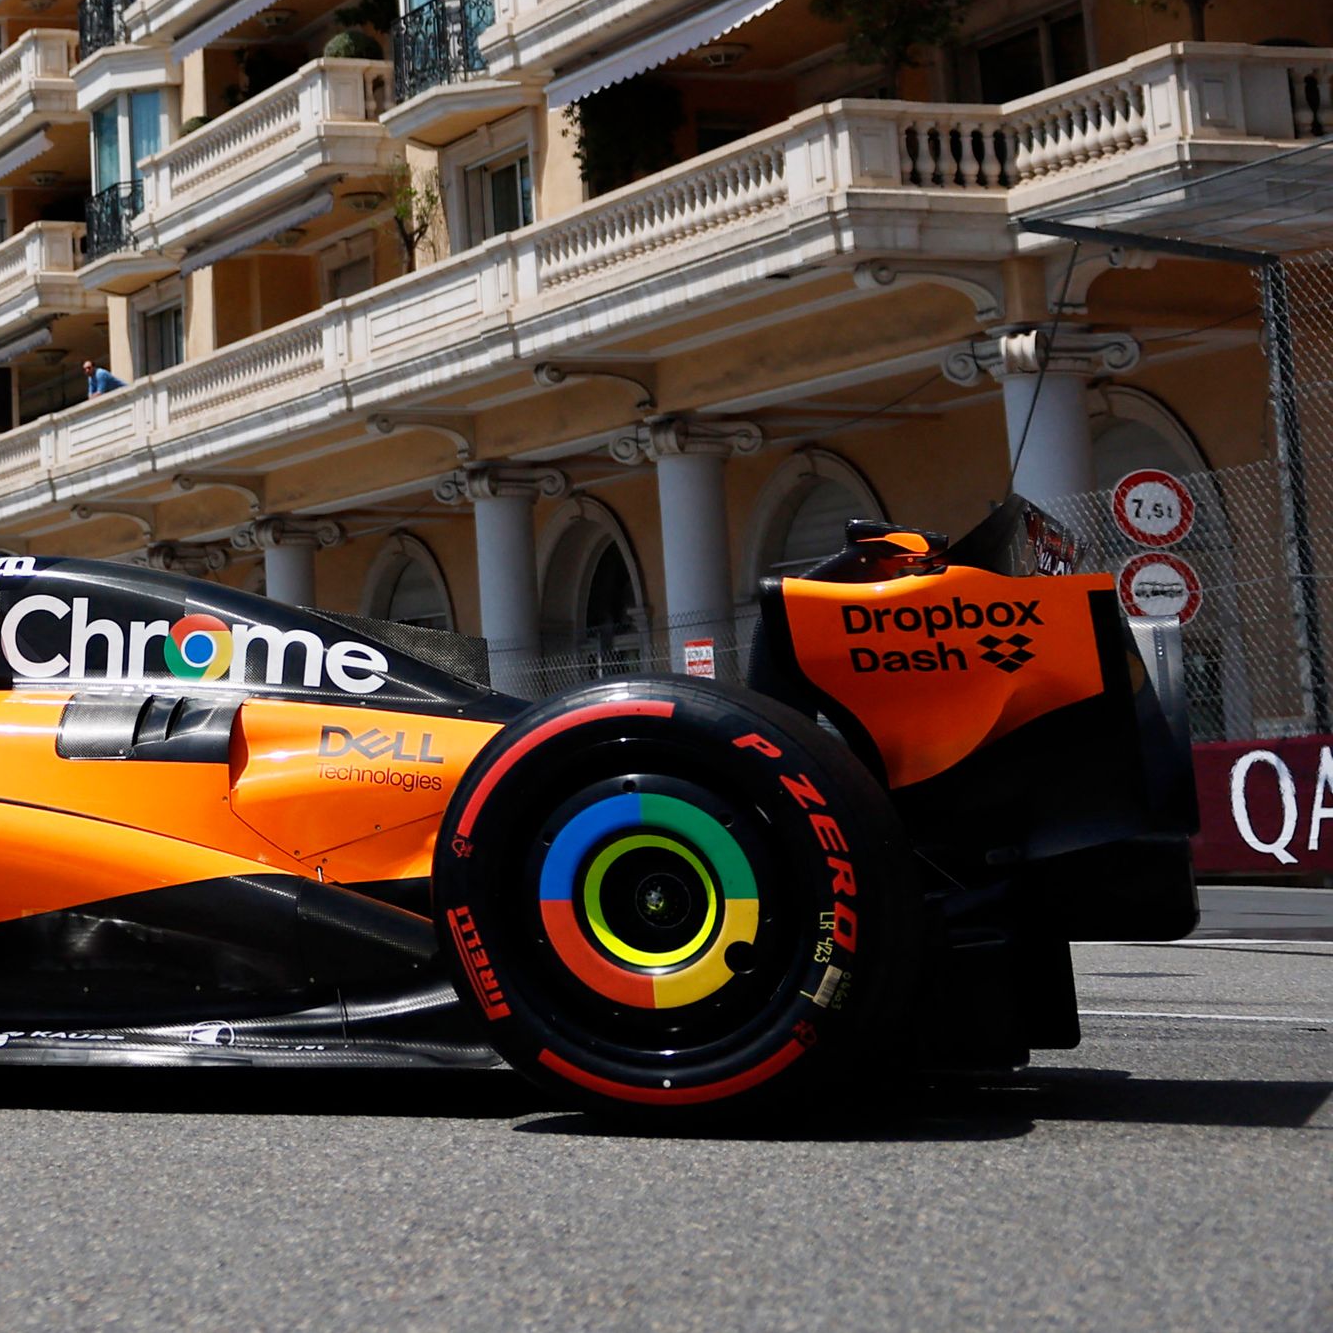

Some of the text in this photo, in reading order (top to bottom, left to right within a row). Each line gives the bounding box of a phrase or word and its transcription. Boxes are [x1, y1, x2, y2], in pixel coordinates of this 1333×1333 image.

[841, 596, 1045, 638] Dropbox
[0, 593, 390, 695] Chrome
[849, 641, 969, 674] Dash
[318, 725, 445, 764] DELL
[317, 762, 443, 792] Technologies
[733, 732, 858, 954] P ZERO
[447, 906, 511, 1020] PIRELLI
